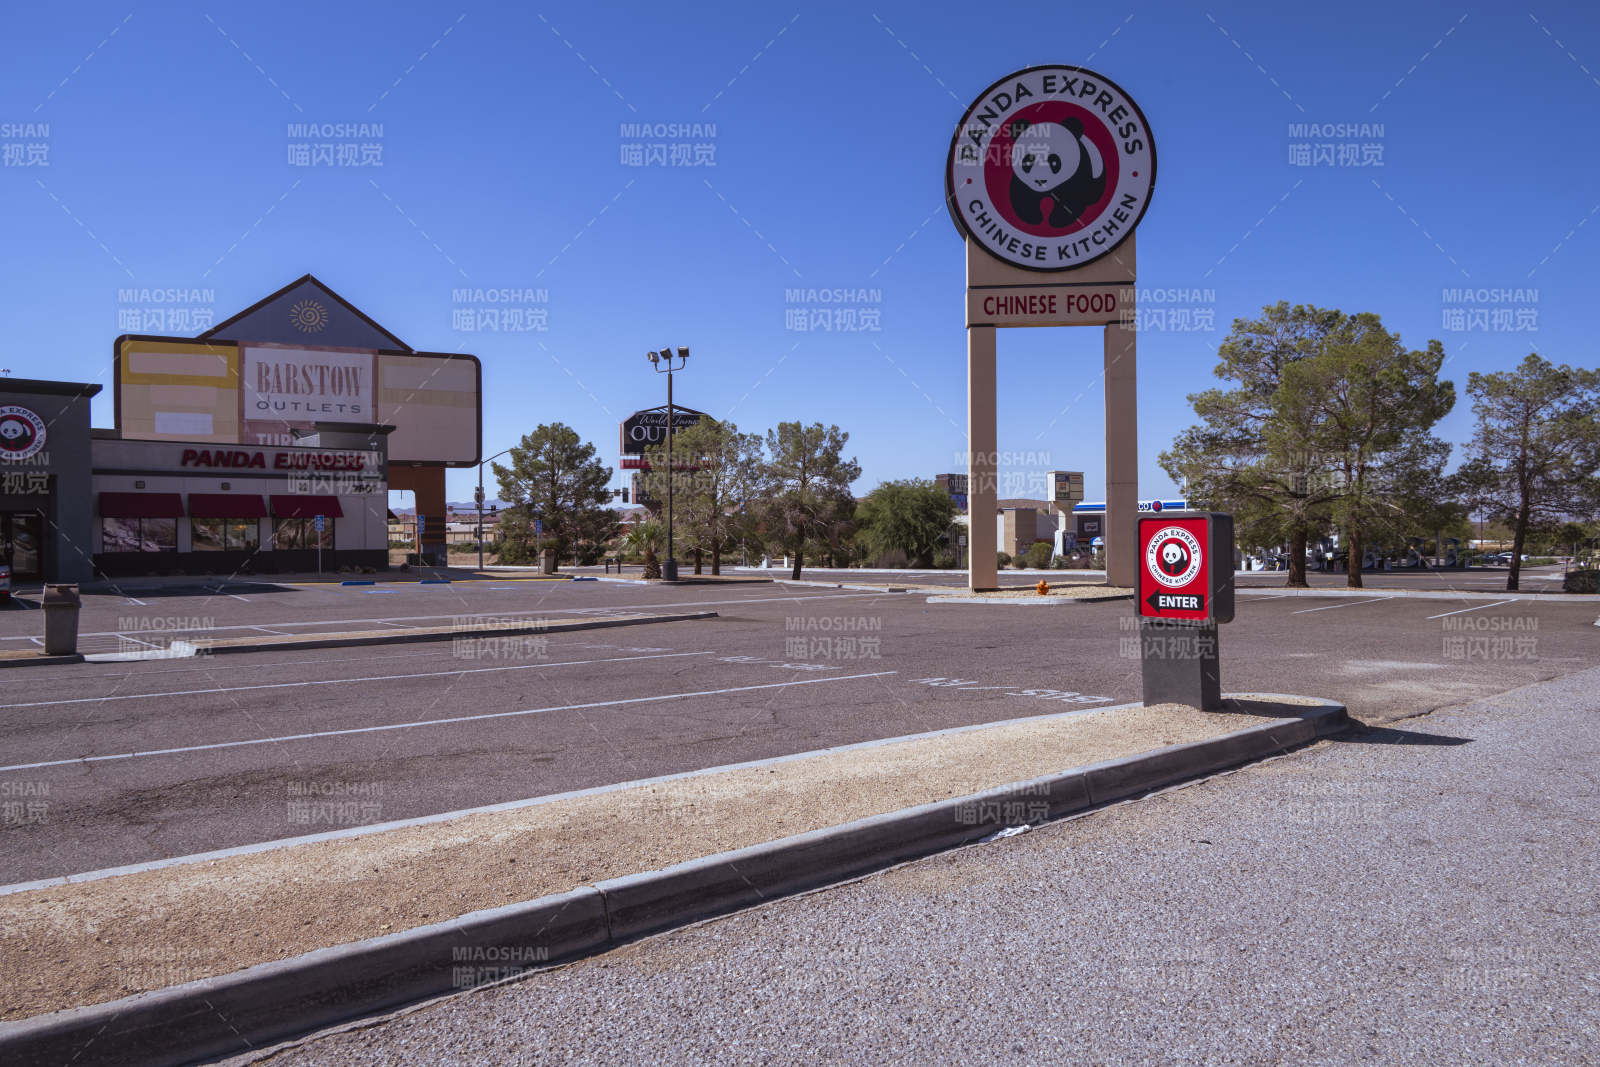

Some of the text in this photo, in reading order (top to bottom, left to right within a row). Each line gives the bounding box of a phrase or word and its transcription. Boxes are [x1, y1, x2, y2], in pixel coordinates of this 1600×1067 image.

[960, 75, 1143, 161] PANDA EXPRESS
[968, 193, 1138, 261] CHINESE KITCHEN
[983, 293, 1117, 316] CHINESE FOOD
[256, 361, 363, 397] BARSTOW
[256, 401, 361, 414] OUTLETS
[181, 448, 266, 470] PANDA
[1150, 530, 1199, 555] PANDA EXPRESS
[1151, 564, 1197, 584] CHINESE KITCHEN
[1159, 595, 1198, 608] ENTER
